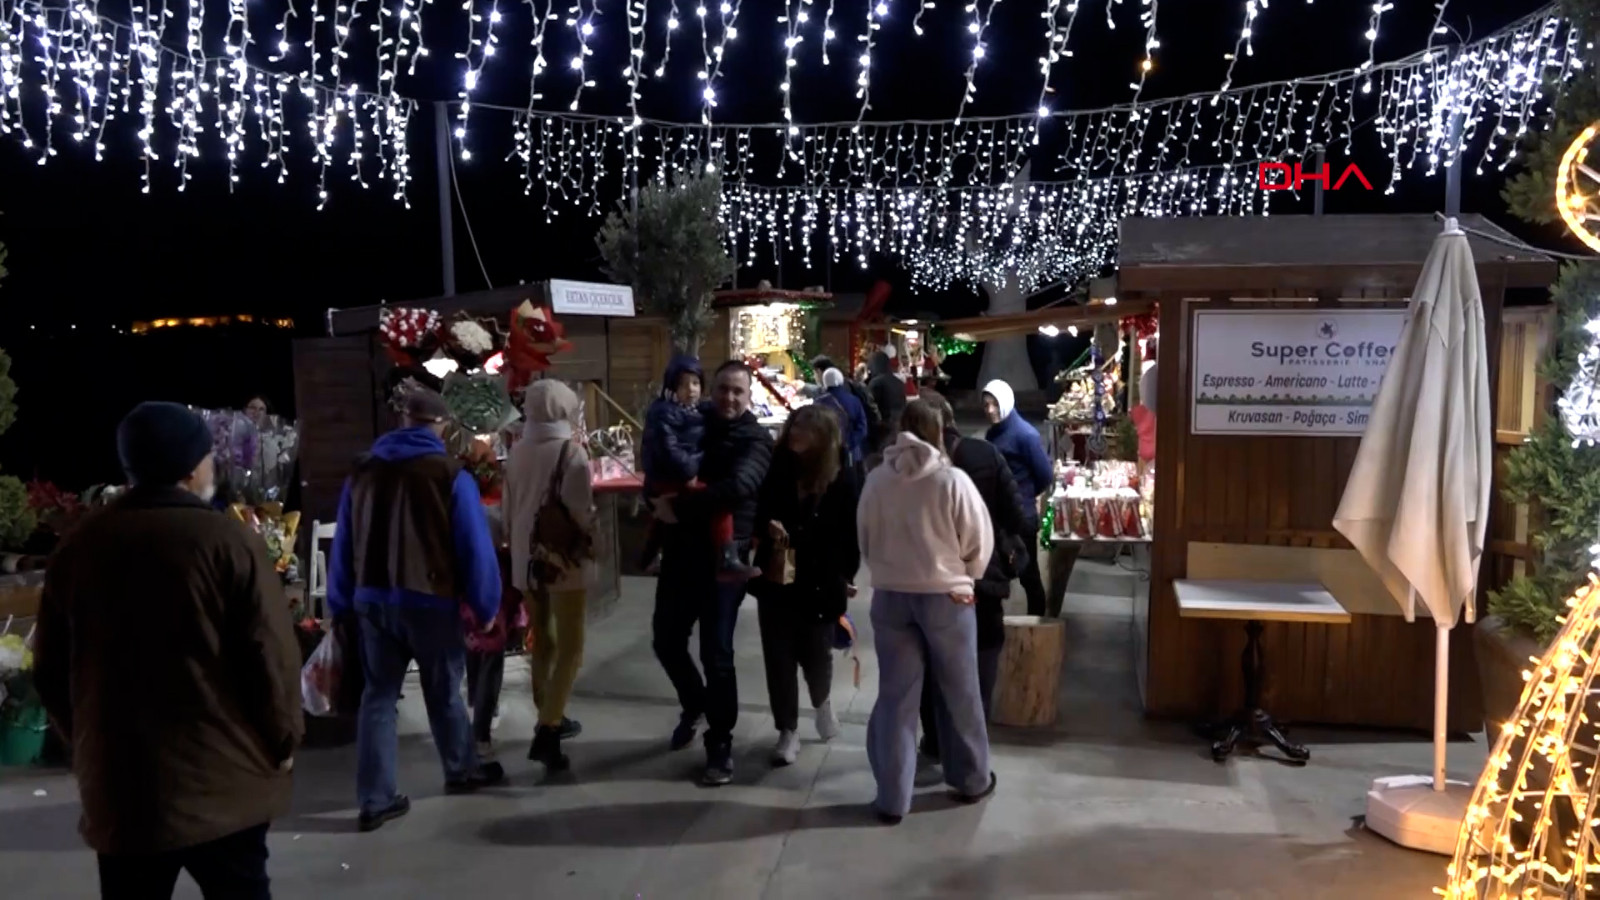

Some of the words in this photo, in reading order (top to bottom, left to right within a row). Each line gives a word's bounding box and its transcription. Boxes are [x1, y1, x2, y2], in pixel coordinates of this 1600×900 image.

[1251, 341, 1318, 365] Super
[1203, 374, 1255, 389] Espresso
[1264, 373, 1327, 388] Americano
[1337, 374, 1368, 388] Latte
[1228, 410, 1283, 424] Kruvasan
[1293, 410, 1336, 427] Poğaça
